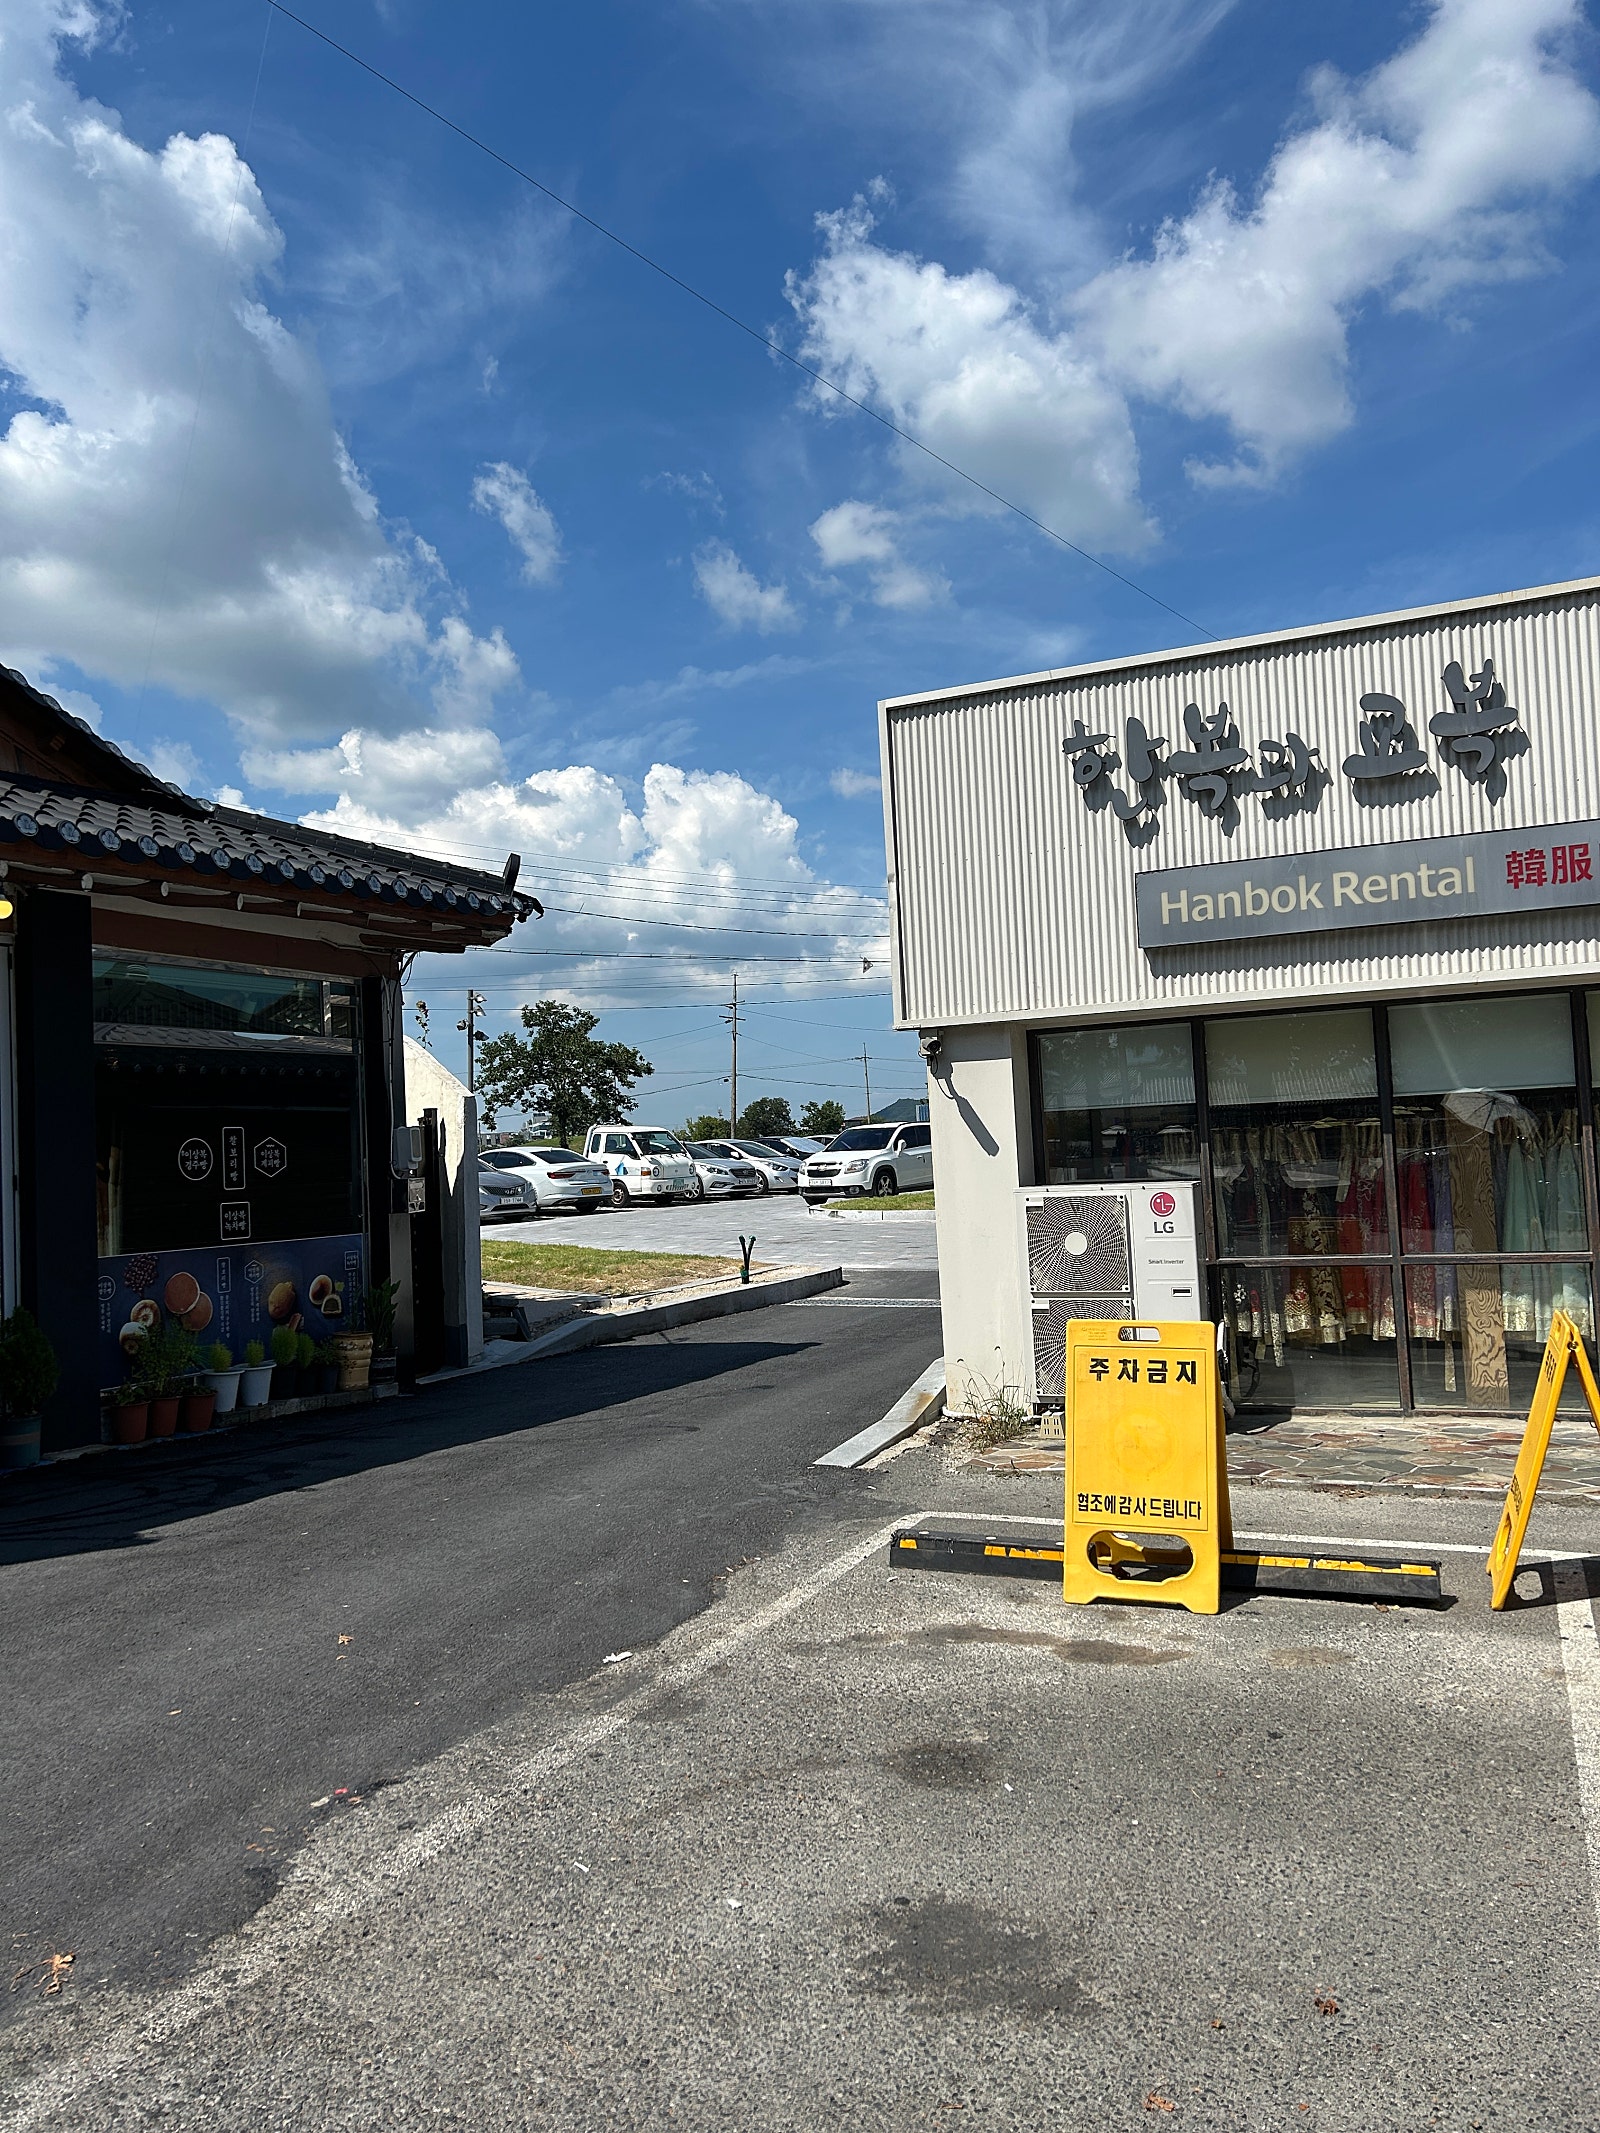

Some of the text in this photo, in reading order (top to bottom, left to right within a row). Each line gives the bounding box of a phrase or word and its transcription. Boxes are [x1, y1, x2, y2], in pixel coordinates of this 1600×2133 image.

[1063, 658, 1518, 821] 한복과 교복
[1505, 843, 1593, 889] 韓服
[1160, 855, 1476, 925] Hanbok Rental
[1153, 1221, 1175, 1234] LG
[1089, 1358, 1197, 1385] 주차금지
